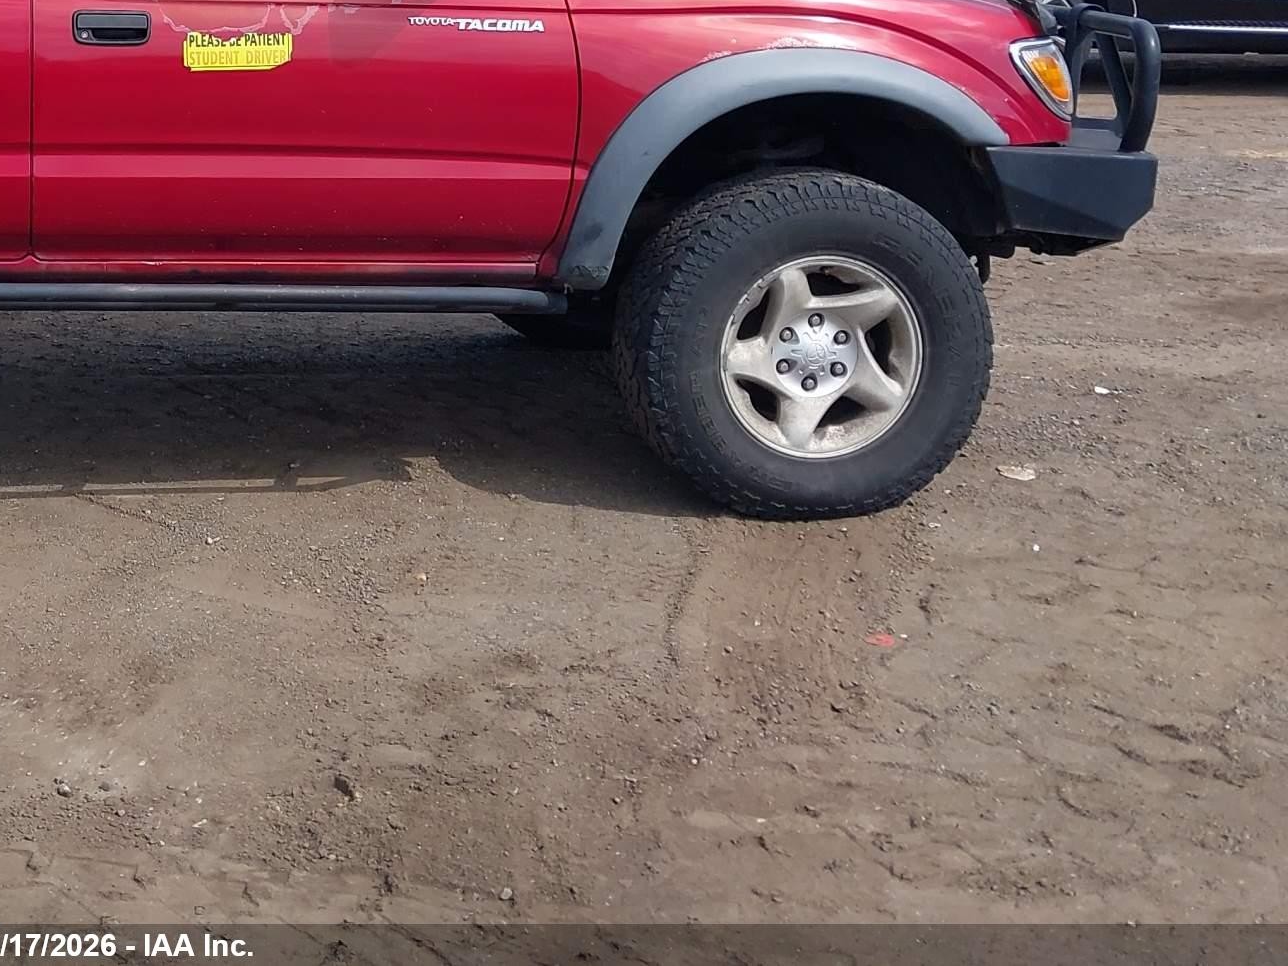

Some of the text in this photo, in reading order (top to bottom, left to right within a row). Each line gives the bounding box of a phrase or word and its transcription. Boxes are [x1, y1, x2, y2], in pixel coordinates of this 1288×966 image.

[407, 16, 545, 32] TOYOTA TACOMA
[244, 33, 286, 47] PATIENT
[189, 49, 287, 66] STUDENT DRIVER
